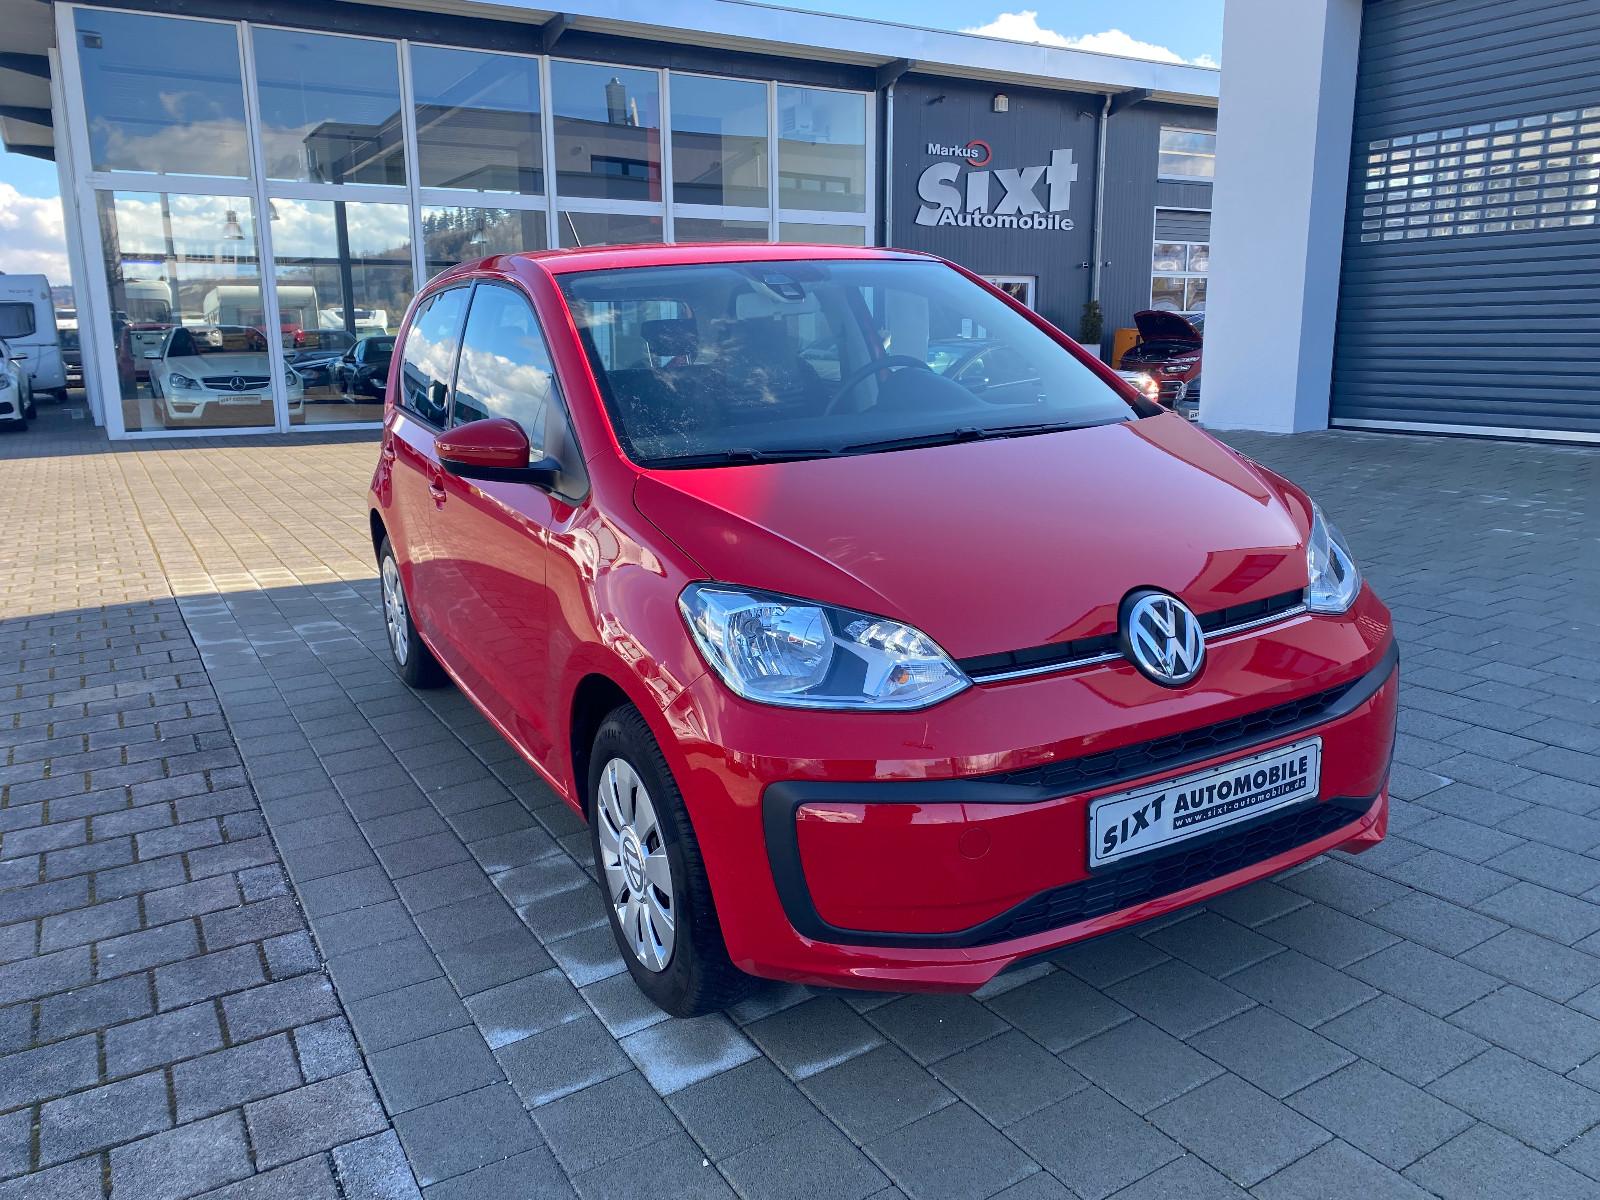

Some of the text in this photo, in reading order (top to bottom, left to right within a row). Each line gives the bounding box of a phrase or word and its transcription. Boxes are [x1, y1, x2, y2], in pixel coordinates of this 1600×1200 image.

[927, 142, 979, 158] Markus
[914, 148, 1079, 227] Sixt
[938, 206, 1075, 231] Automobile
[1102, 755, 1309, 855] SIXT AUTOMOBILE
[1175, 779, 1306, 827] www.sixt-automobile.de
